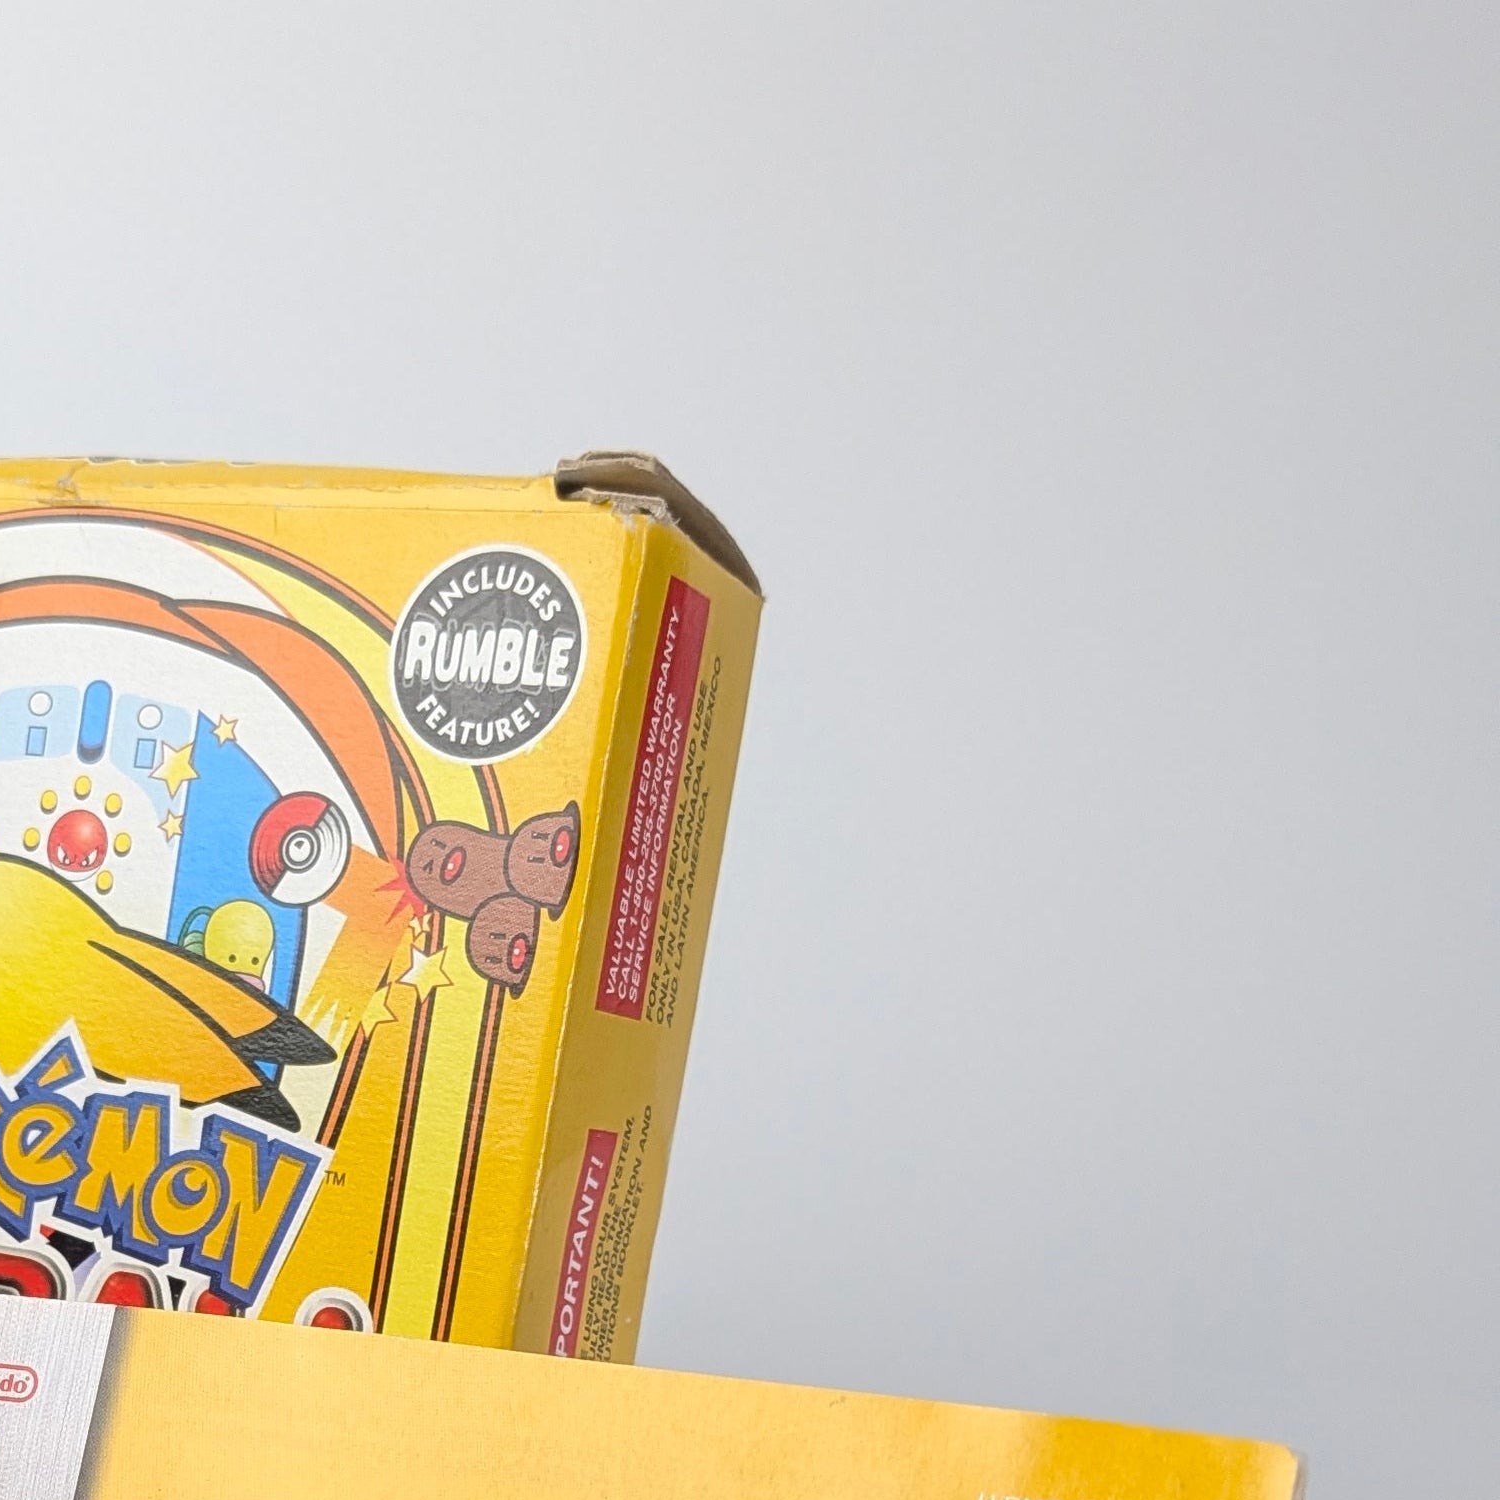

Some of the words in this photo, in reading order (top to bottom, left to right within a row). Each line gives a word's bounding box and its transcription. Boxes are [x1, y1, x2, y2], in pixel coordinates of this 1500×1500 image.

[402, 620, 574, 689] RUMBLE
[428, 564, 563, 622] INCLUDES
[415, 693, 543, 747] FEATURE!
[605, 864, 635, 995] VALUABLE
[628, 759, 652, 861] LIMITED
[645, 605, 681, 754] WARRANTY
[617, 937, 636, 1000] CALL
[629, 754, 666, 926] 1-800-255-3700
[659, 692, 677, 749] FOR
[628, 900, 653, 1004] SERVICE
[646, 718, 684, 894] INFORMATION
[646, 972, 660, 1022] FOR
[666, 799, 688, 891] RENTAL
[683, 737, 697, 791] AND
[693, 678, 708, 733] USE
[656, 965, 671, 1025] ONLY
[666, 931, 677, 958] IN
[700, 655, 722, 751] MEXICO
[666, 976, 679, 1029] AND
[674, 904, 690, 971] LATIN
[639, 1104, 652, 1153] AND
[555, 1154, 604, 1358] PORTANT!
[582, 1274, 599, 1342] USING
[593, 1212, 611, 1270] YOUR
